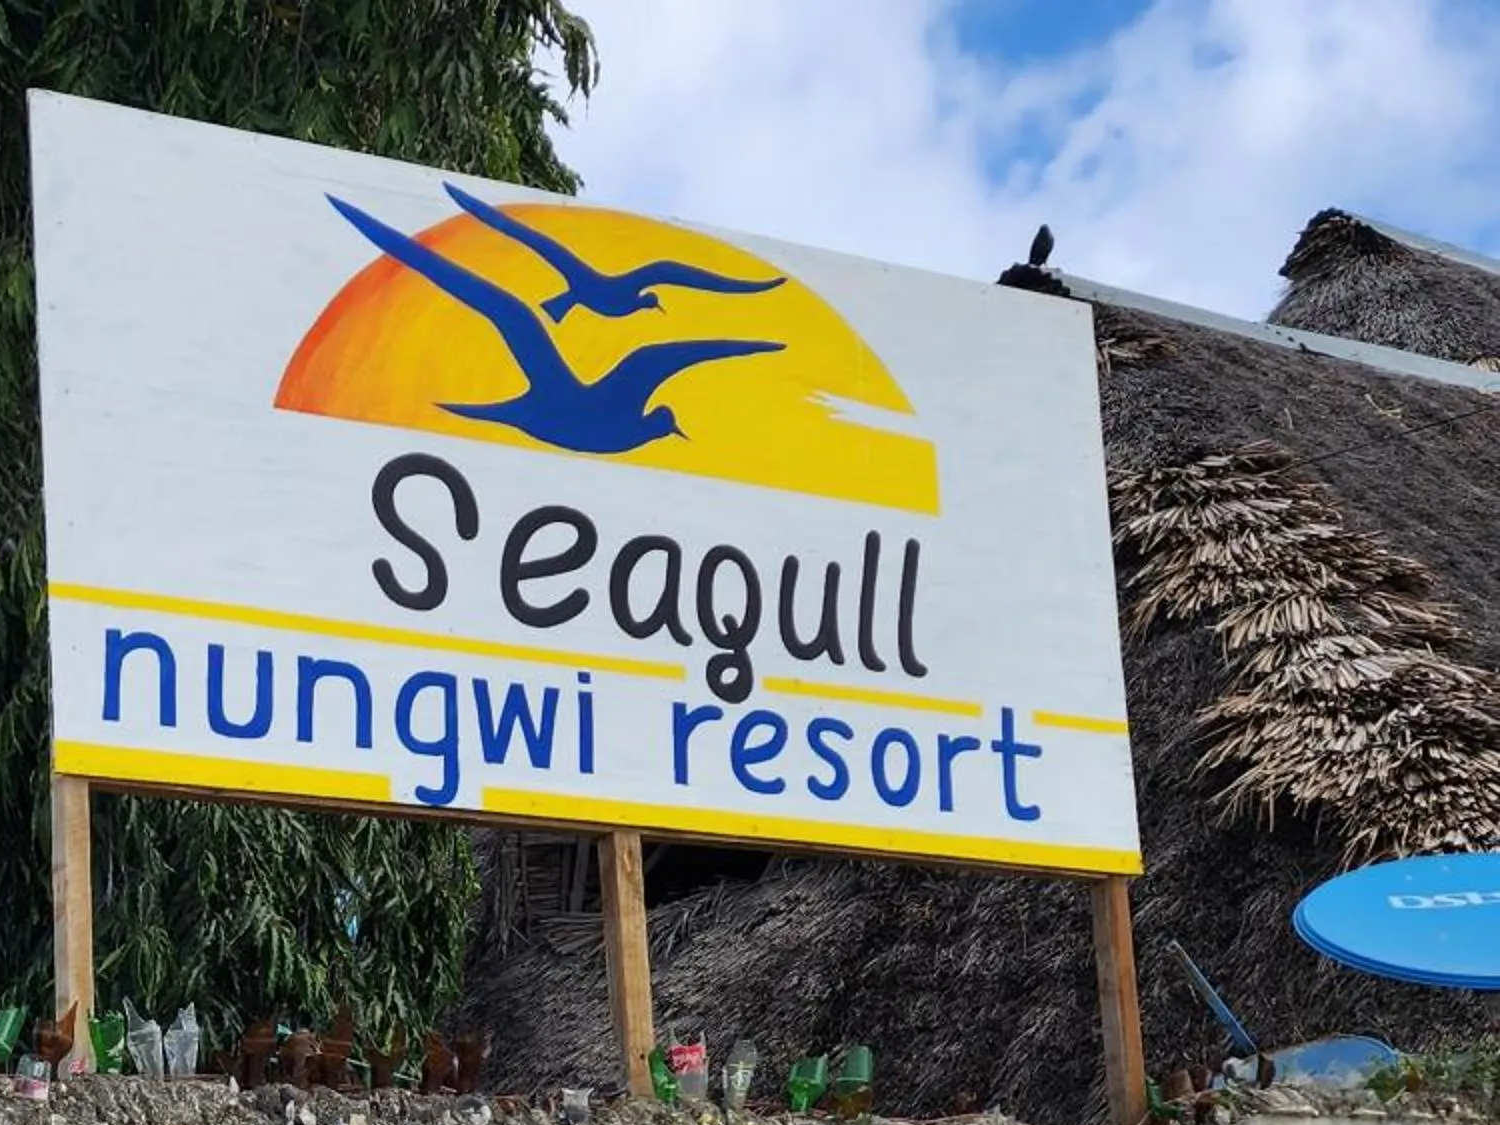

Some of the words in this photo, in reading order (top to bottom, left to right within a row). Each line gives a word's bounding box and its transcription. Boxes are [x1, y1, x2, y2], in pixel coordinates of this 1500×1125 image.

[371, 452, 928, 704] Seagull
[102, 624, 595, 806] nungwi
[672, 700, 1043, 822] resort
